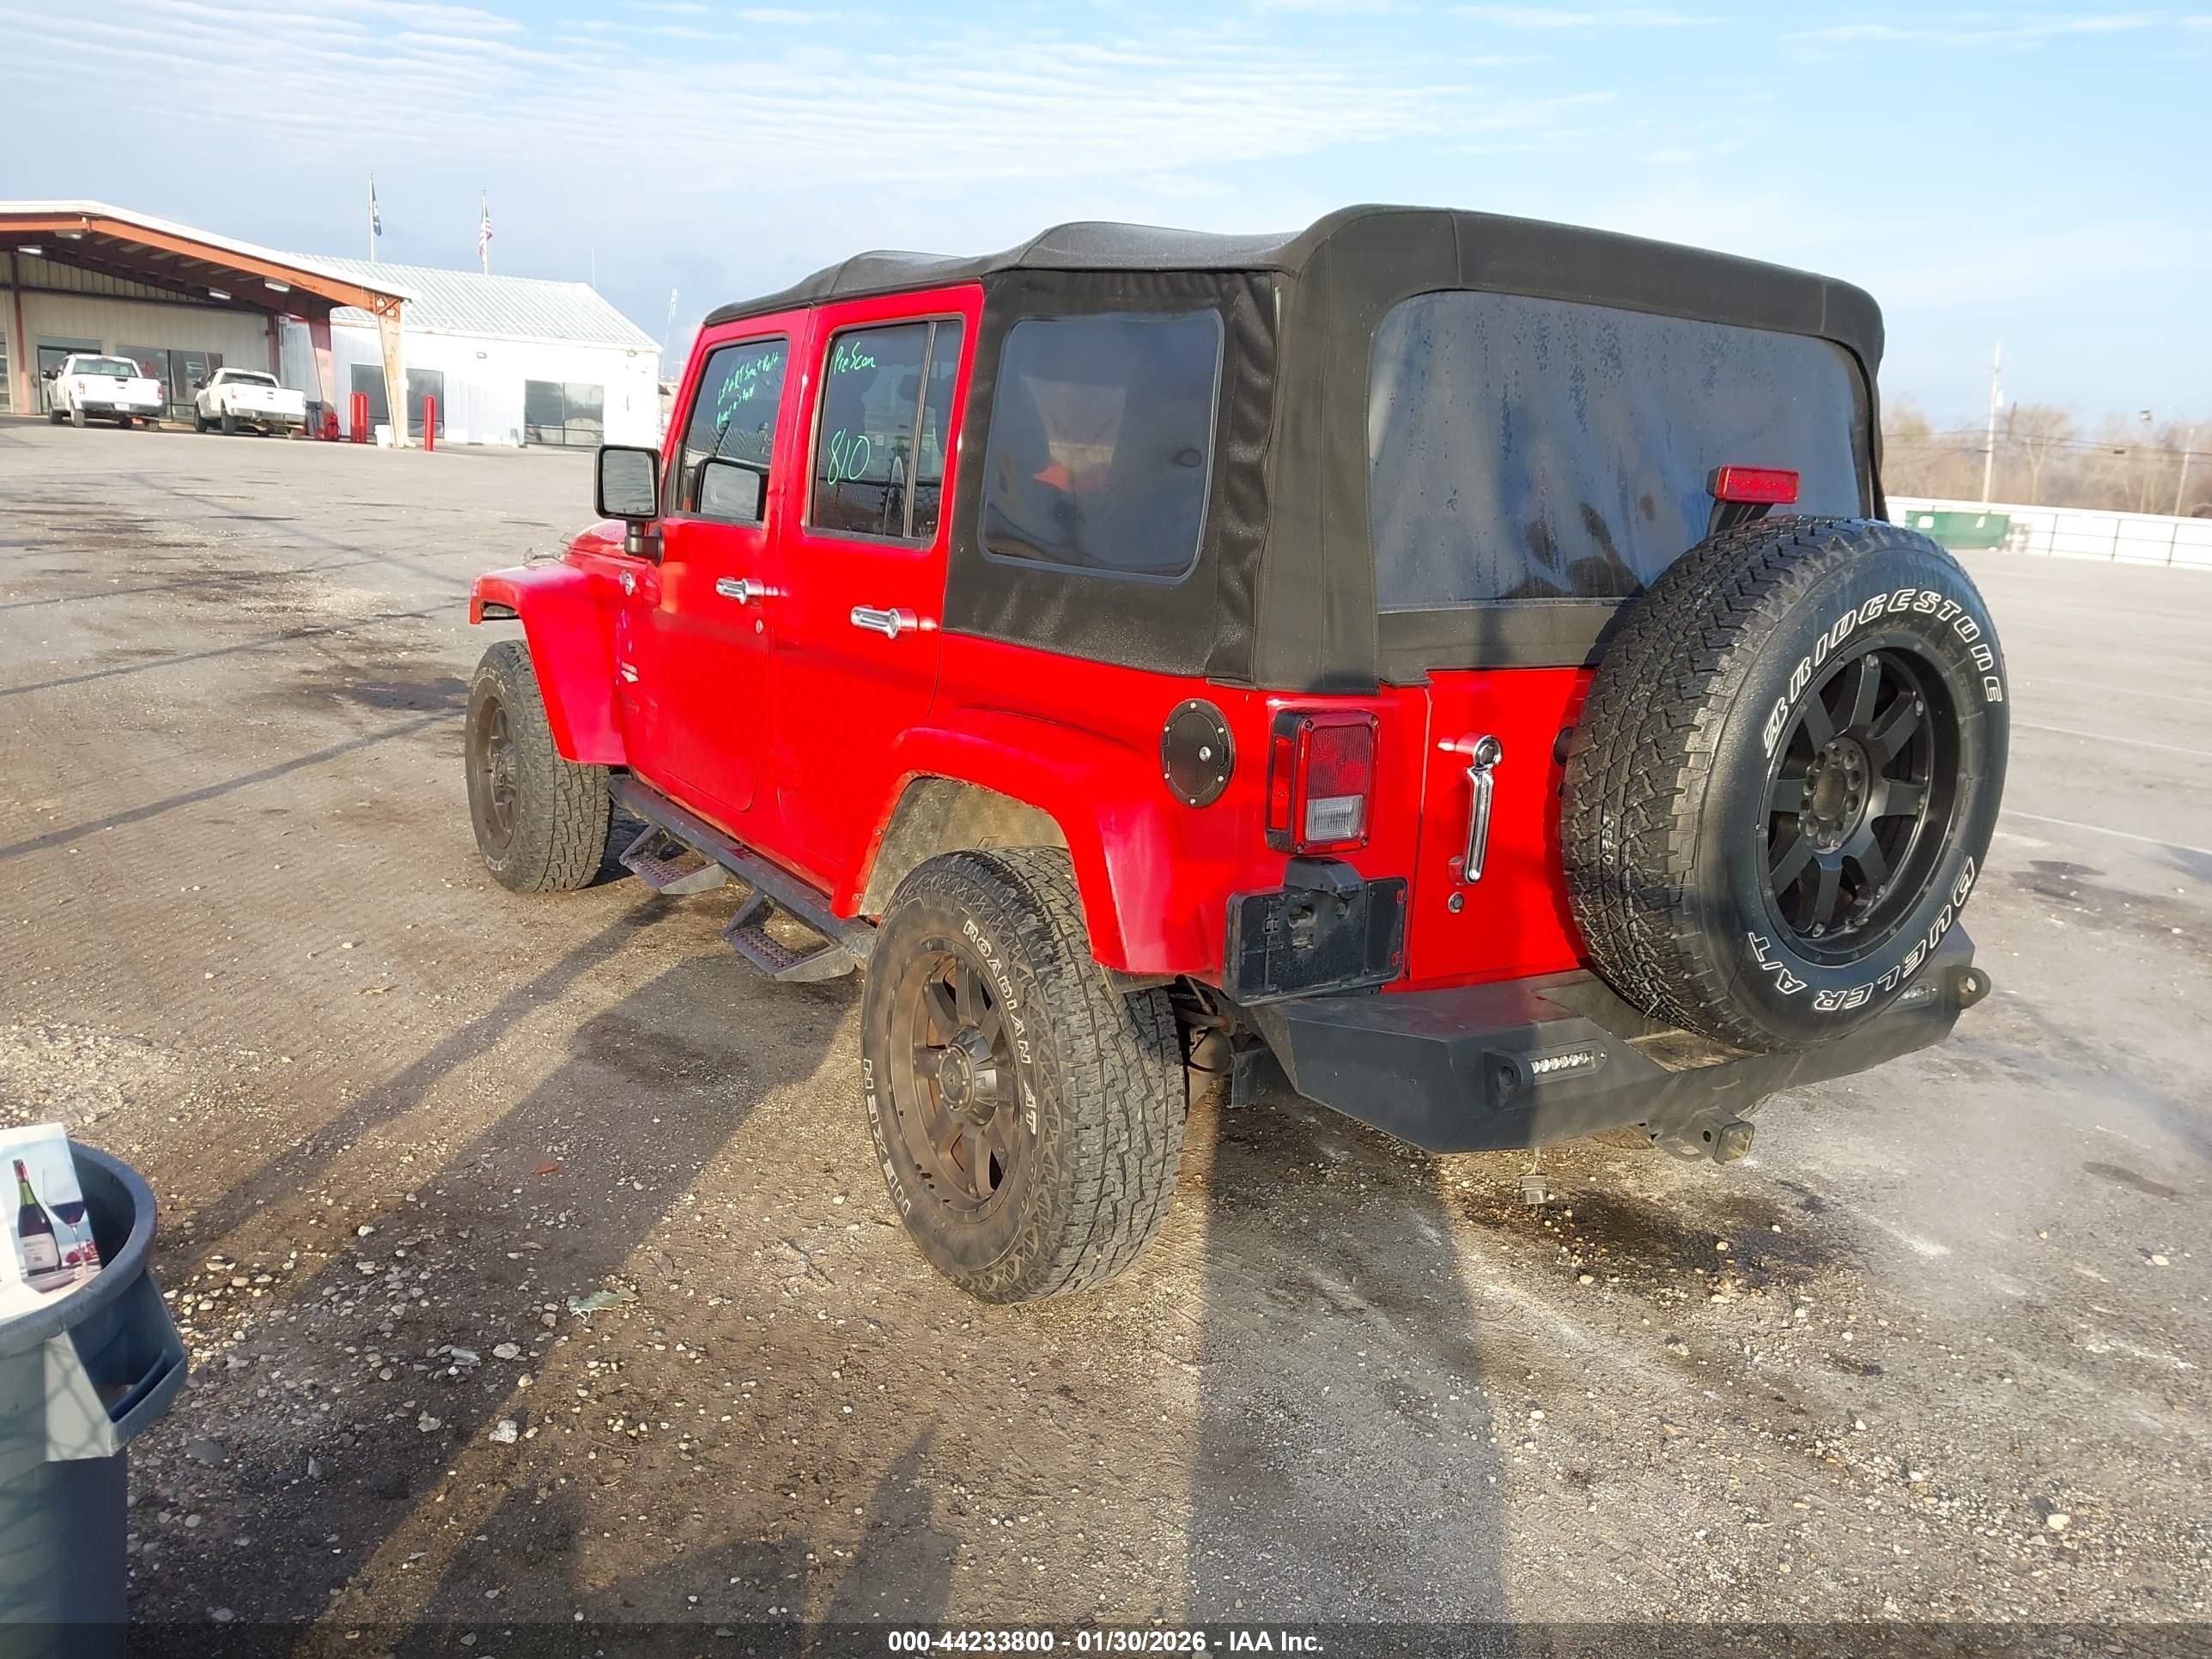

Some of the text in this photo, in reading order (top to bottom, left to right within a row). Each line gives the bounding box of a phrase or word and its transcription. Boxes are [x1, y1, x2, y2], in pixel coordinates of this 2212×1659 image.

[833, 341, 877, 375] Pre Scan
[827, 427, 872, 485] 810
[1762, 588, 2003, 758] BRIDGESTONE
[1747, 856, 1976, 1011] DUELER A/T
[962, 919, 1039, 1137] ROADIAN AT
[863, 1058, 911, 1218] NEXEN
